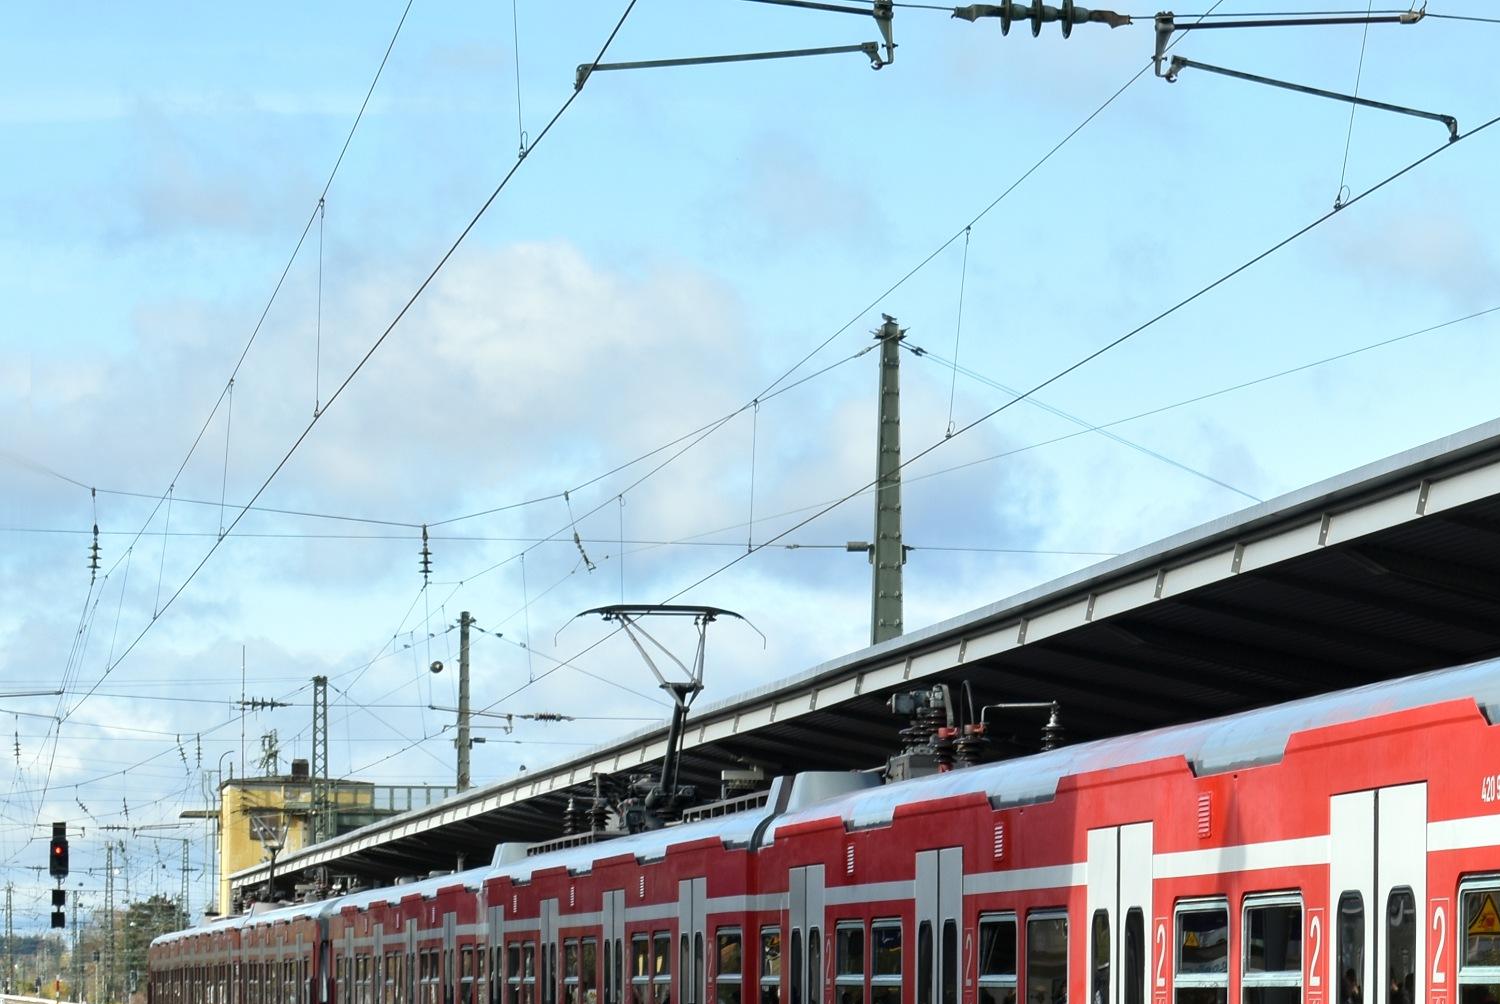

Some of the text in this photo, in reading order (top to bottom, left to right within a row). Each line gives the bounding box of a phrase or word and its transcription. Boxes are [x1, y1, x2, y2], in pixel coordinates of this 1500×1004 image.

[1481, 775, 1495, 803] 420
[1156, 924, 1166, 986] 2
[1309, 915, 1321, 986] 2
[1428, 906, 1446, 984] 2
